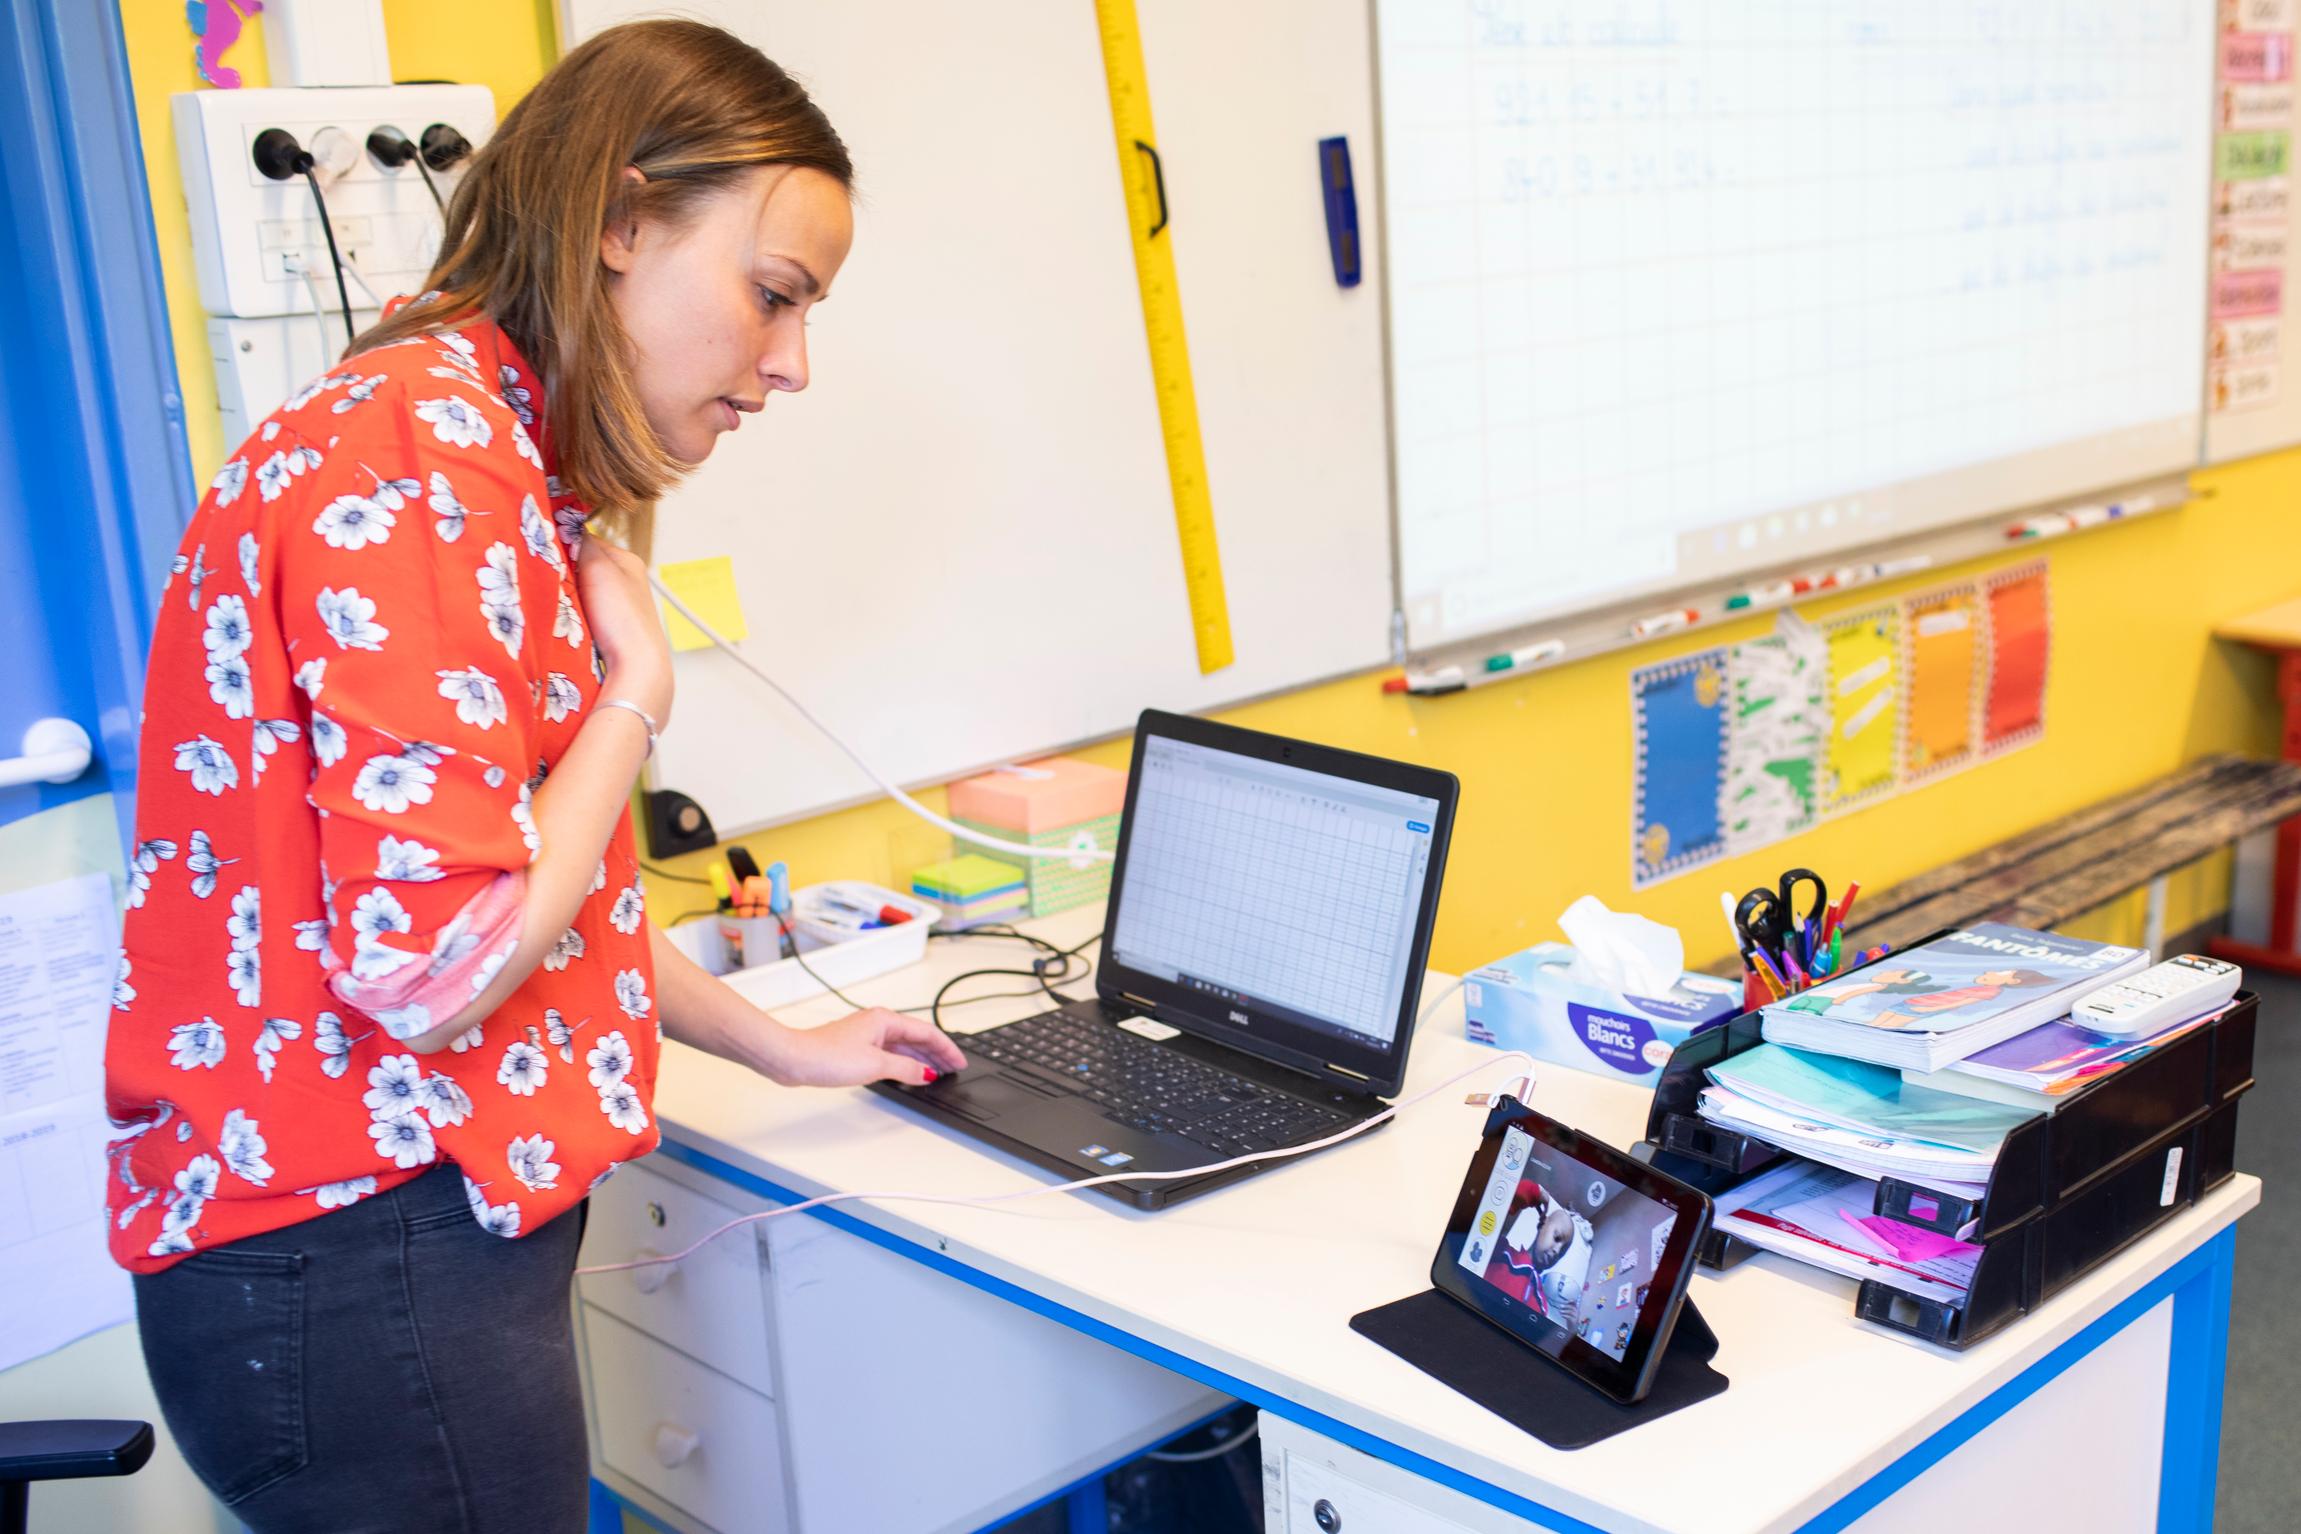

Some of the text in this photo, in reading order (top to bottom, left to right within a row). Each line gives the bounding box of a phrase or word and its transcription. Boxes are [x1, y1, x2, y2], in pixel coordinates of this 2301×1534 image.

[1949, 931, 2106, 970] FANTÔMES
[1229, 1010, 1248, 1025] DELL
[1587, 1015, 1631, 1032] mouchoirs
[1588, 1024, 1635, 1050] Blancs
